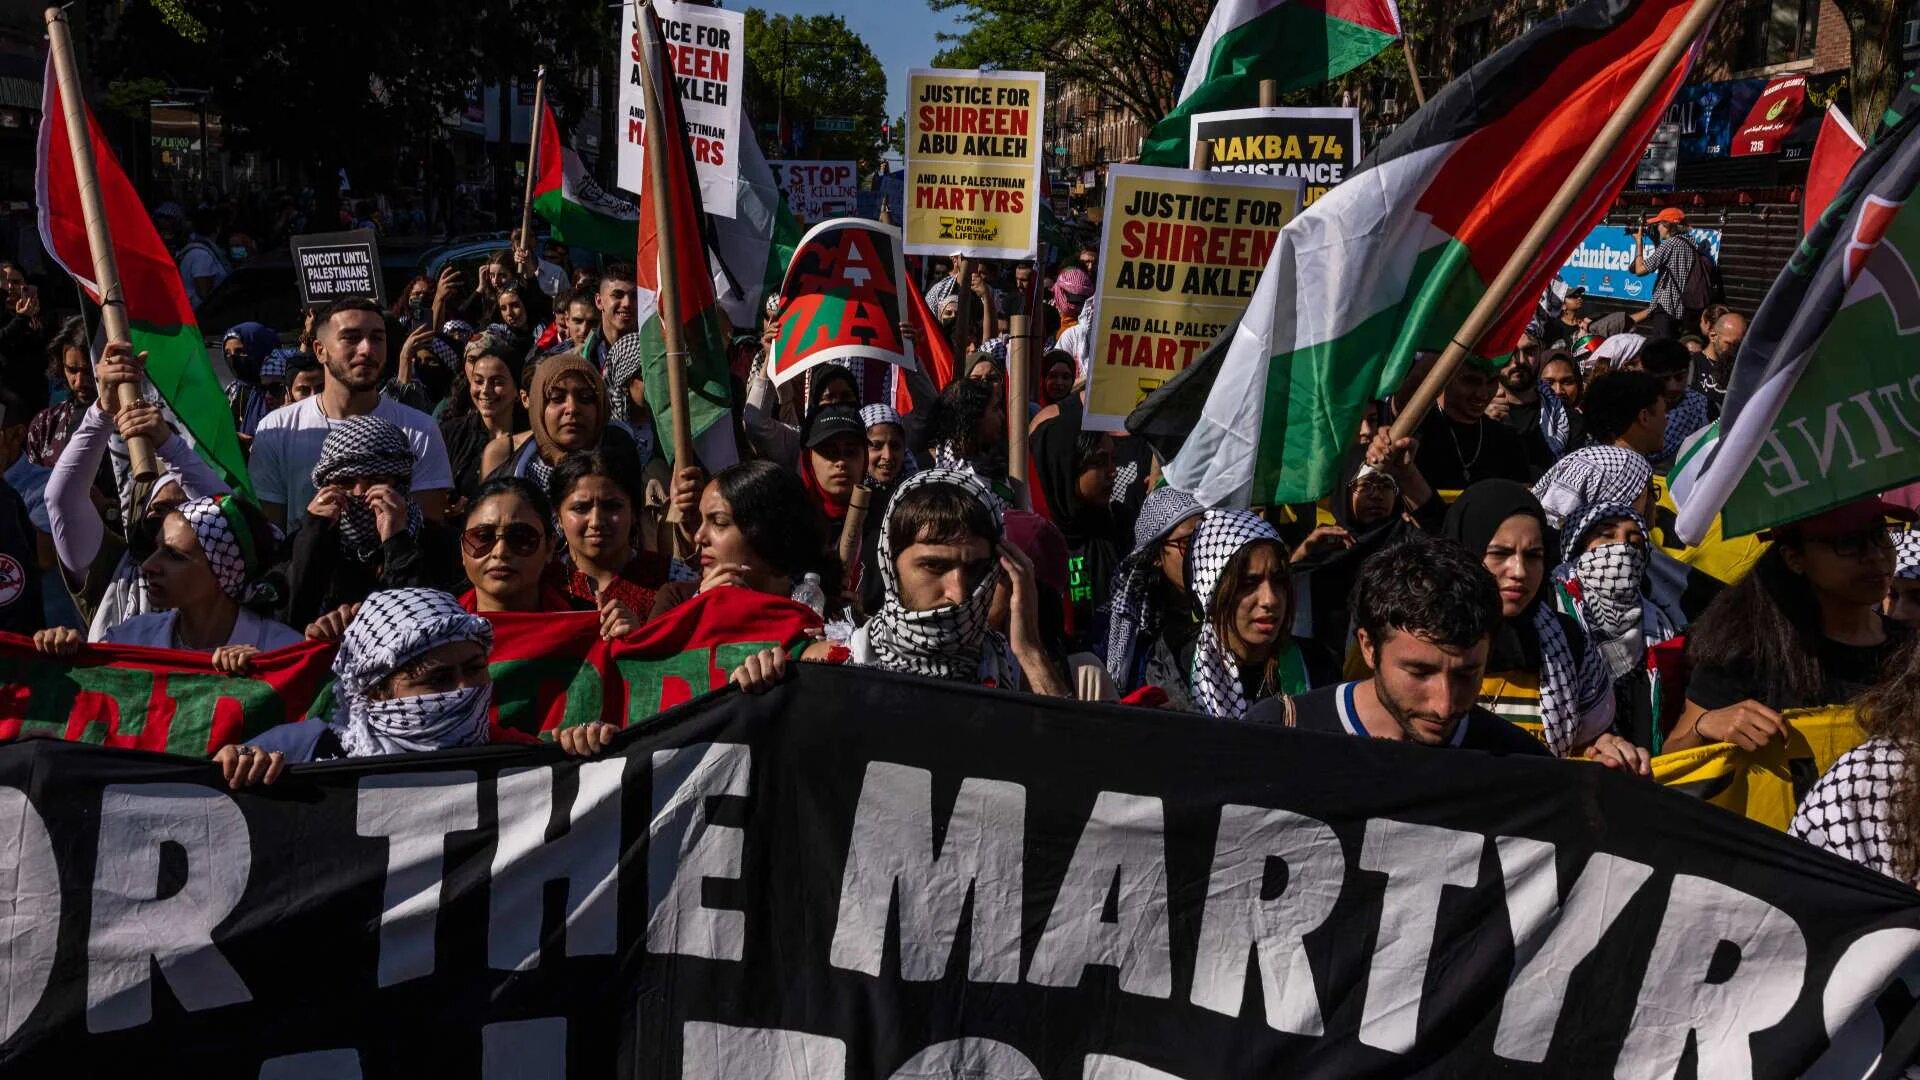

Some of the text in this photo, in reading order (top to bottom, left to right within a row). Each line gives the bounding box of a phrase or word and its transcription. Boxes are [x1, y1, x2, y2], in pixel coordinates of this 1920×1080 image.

[696, 25, 730, 49] FOR
[678, 77, 728, 106] KLEH
[919, 85, 1030, 107] JUSTICE FOR
[629, 106, 645, 120] AND
[918, 106, 1029, 136] SHIREEN
[917, 134, 1027, 158] ABU AKLEH
[1211, 135, 1344, 162] NAKBA 74
[789, 165, 850, 186] STOP
[916, 174, 1025, 189] AND ALL PALESTINIAN
[811, 185, 857, 198] KILLING
[916, 186, 1024, 214] MARTYRS
[1125, 190, 1283, 227] JUSTICE FOR
[955, 217, 986, 225] WITHIN
[955, 232, 993, 241] LIFETIME
[1120, 220, 1280, 267] SHIREEN
[302, 251, 370, 266] BOYCOTT UNTIL
[307, 265, 369, 280] PALESTINIANS
[1116, 261, 1175, 292] ABU
[309, 280, 371, 294] HAVE JUSTICE
[1111, 316, 1225, 338] AND ALL PALEST
[1107, 334, 1212, 371] MART
[356, 742, 751, 989] THE
